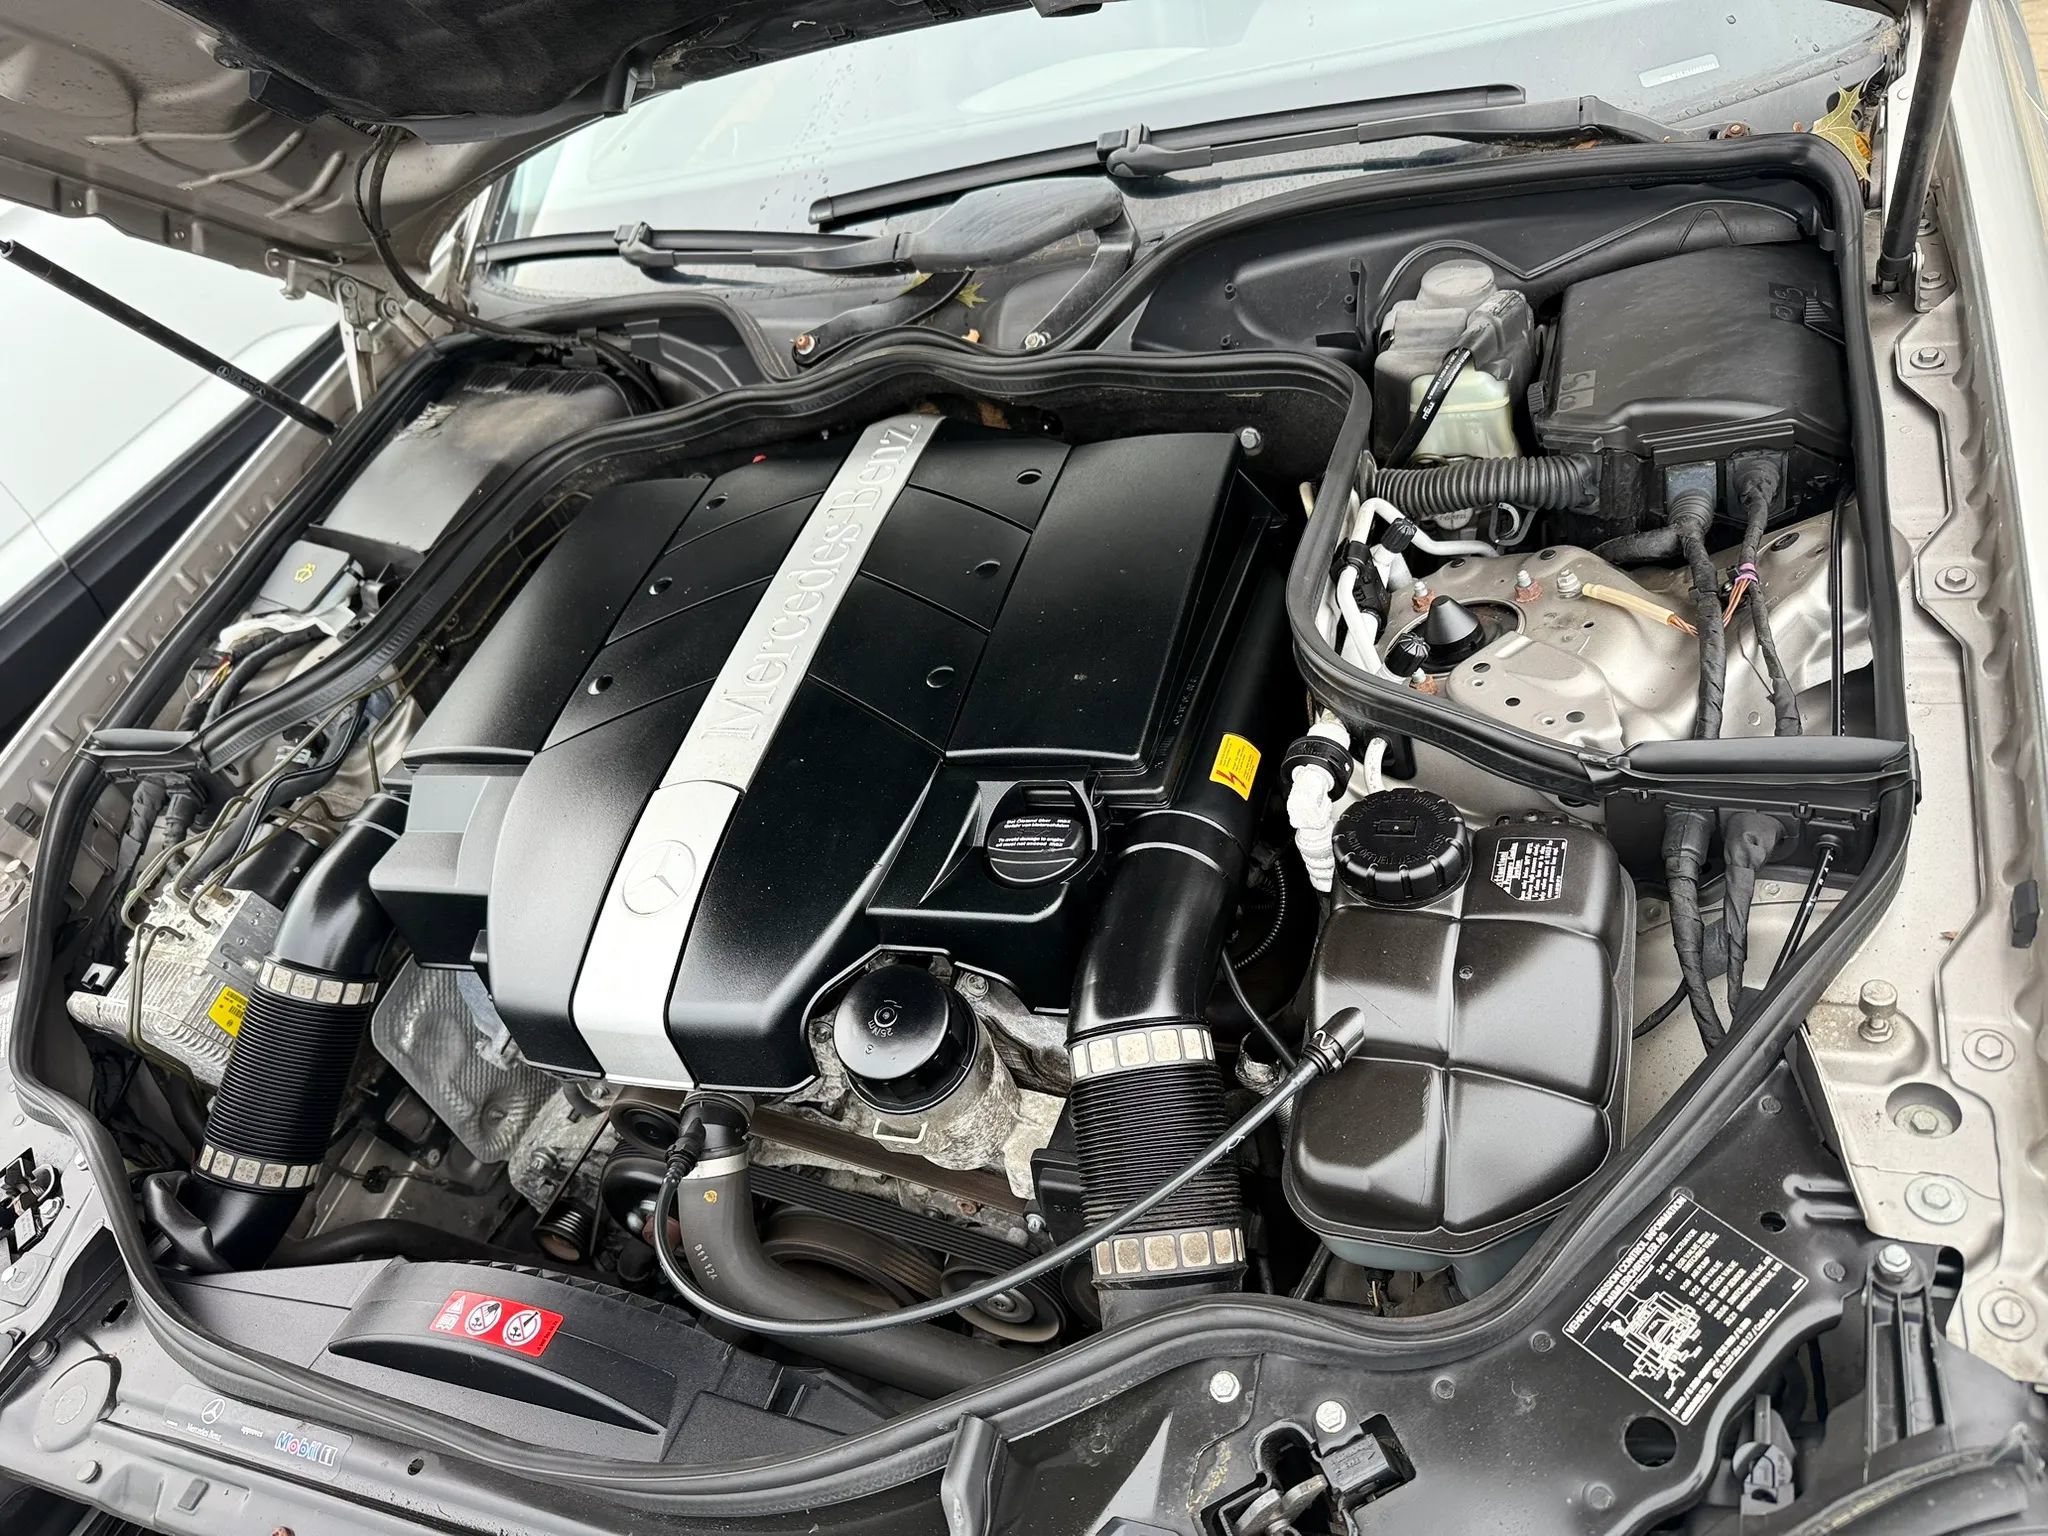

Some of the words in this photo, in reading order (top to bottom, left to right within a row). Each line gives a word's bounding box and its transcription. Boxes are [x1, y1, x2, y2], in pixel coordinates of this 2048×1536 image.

[701, 424, 922, 740] Mercedes-Benz
[1565, 1303, 1595, 1335] VEHICLE
[1590, 1270, 1623, 1306] EMISSION
[1618, 1238, 1650, 1274] CONTROL
[1644, 1195, 1687, 1242] INFORMATION
[1602, 1242, 1660, 1308] DAIMLERCHRYSLER
[1654, 1230, 1669, 1245] AG
[1672, 1228, 1698, 1255] ACTUATOR
[275, 1430, 319, 1461] Mobil
